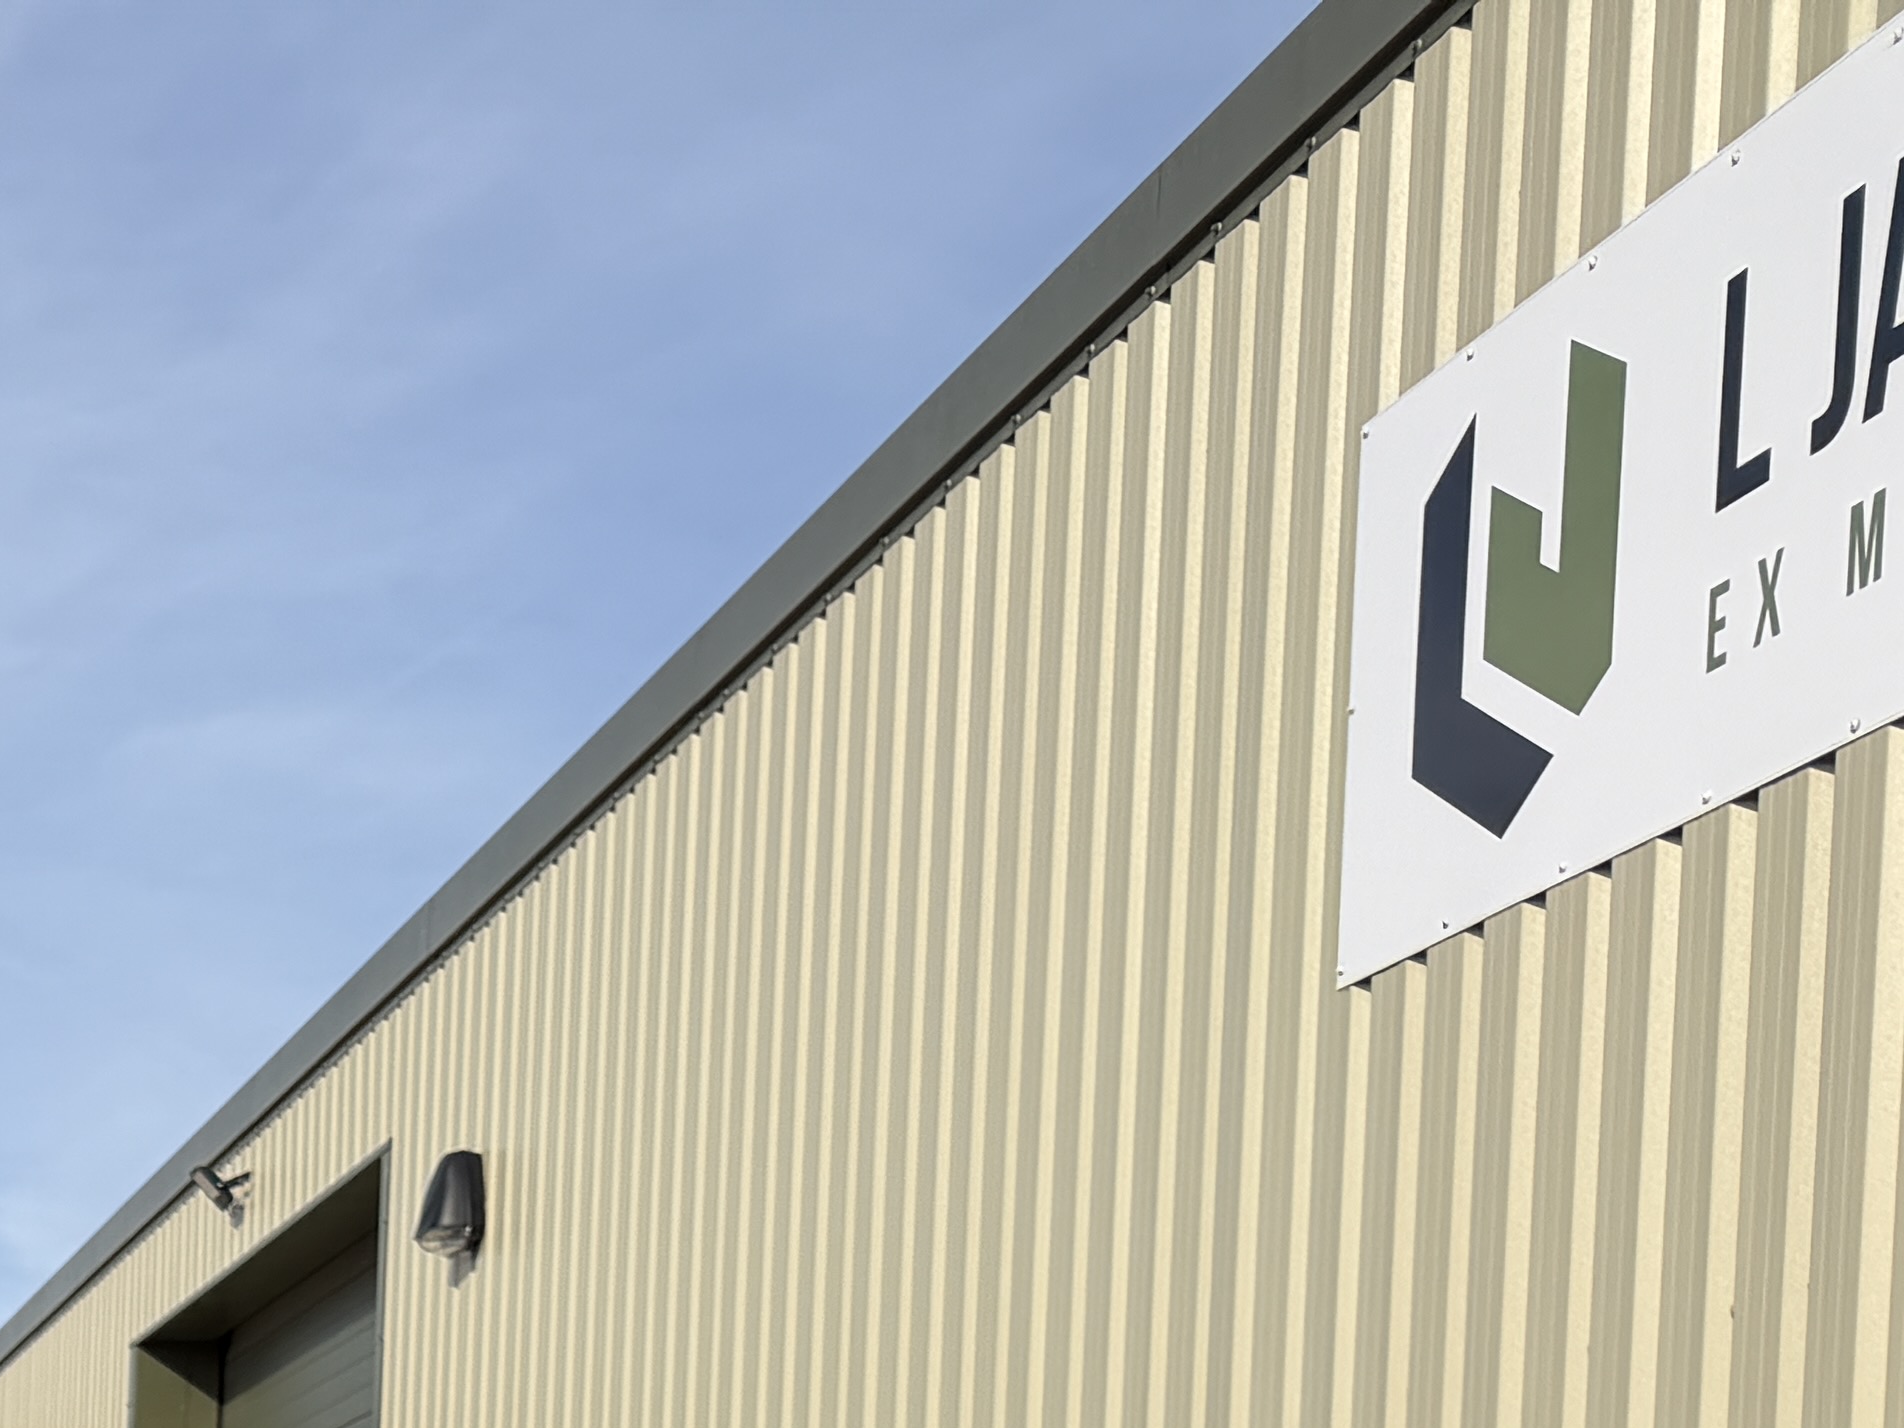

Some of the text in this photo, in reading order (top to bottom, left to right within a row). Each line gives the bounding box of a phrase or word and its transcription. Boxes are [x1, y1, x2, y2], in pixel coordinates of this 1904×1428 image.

[1716, 267, 1772, 513] L
[1706, 487, 1886, 674] EX M
